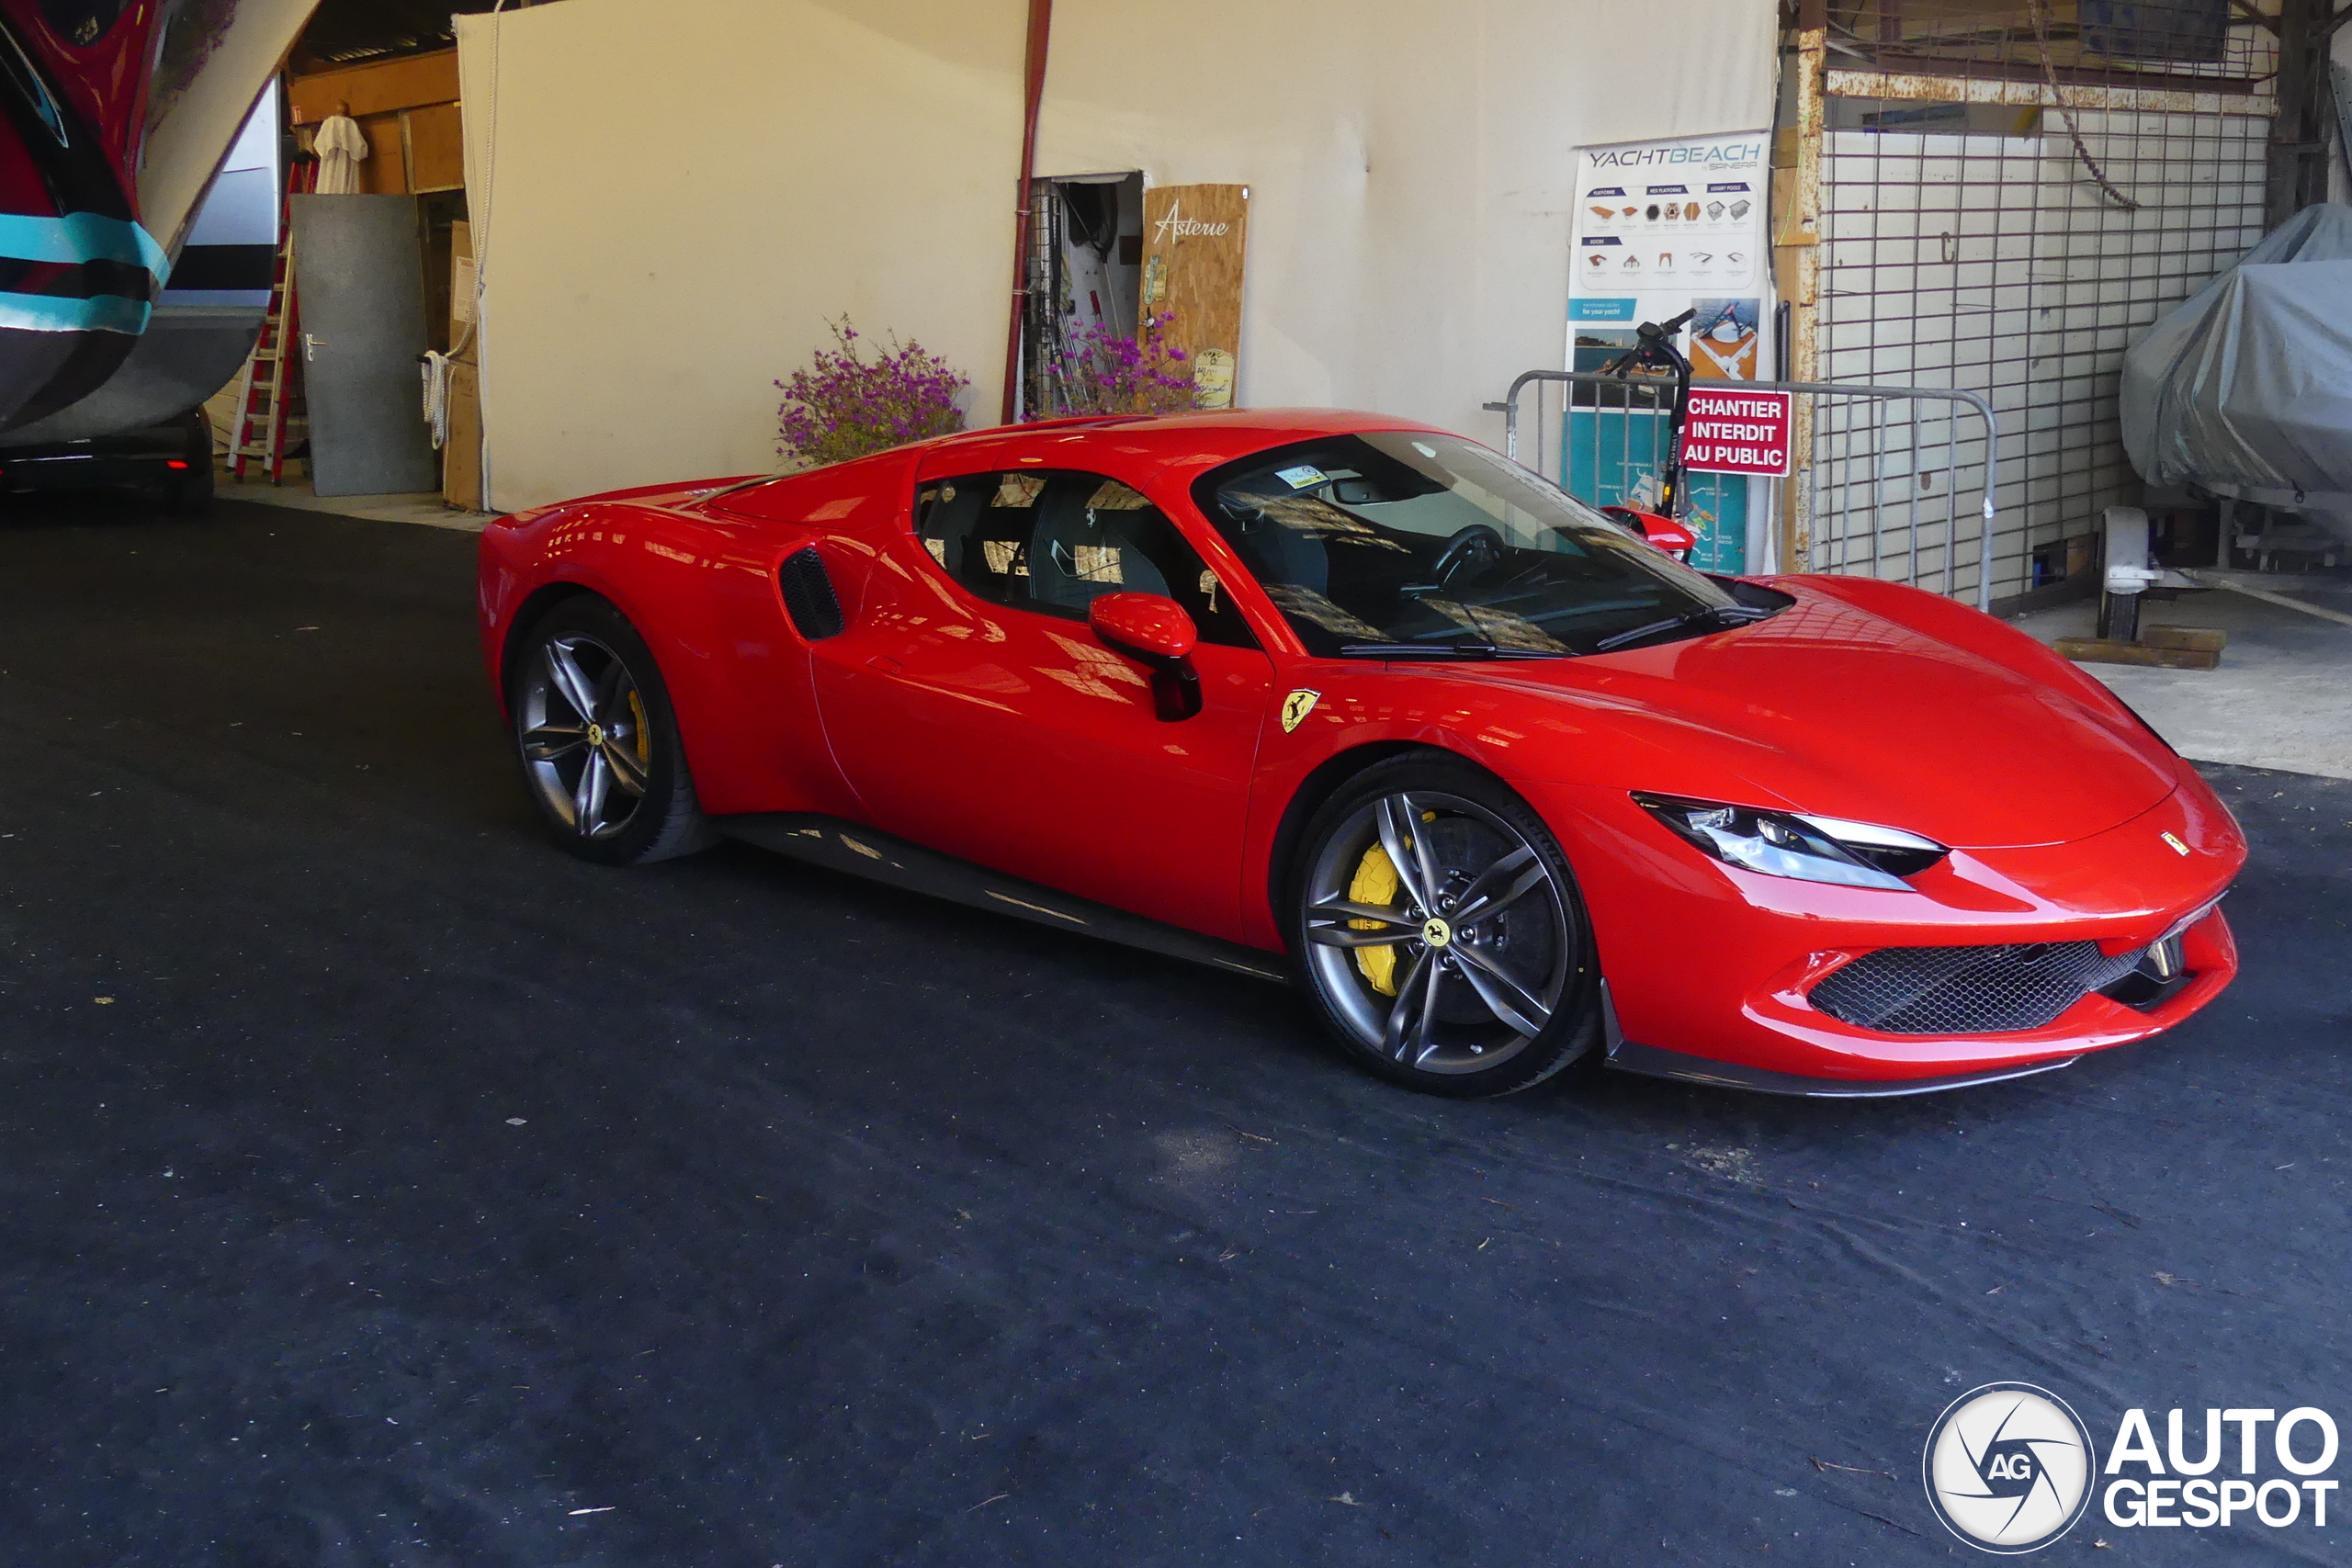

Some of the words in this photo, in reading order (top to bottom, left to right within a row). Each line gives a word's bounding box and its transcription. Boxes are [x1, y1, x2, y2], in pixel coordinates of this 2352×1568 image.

[1589, 144, 1761, 168] YACHTBEACH
[1153, 198, 1230, 244] Asterie
[1688, 398, 1781, 418] CHANTIER
[1692, 422, 1777, 442] INTERDIT
[1684, 445, 1710, 462] AU
[1714, 446, 1783, 467] PUBLIC
[1506, 804, 1566, 866] MICHELIN
